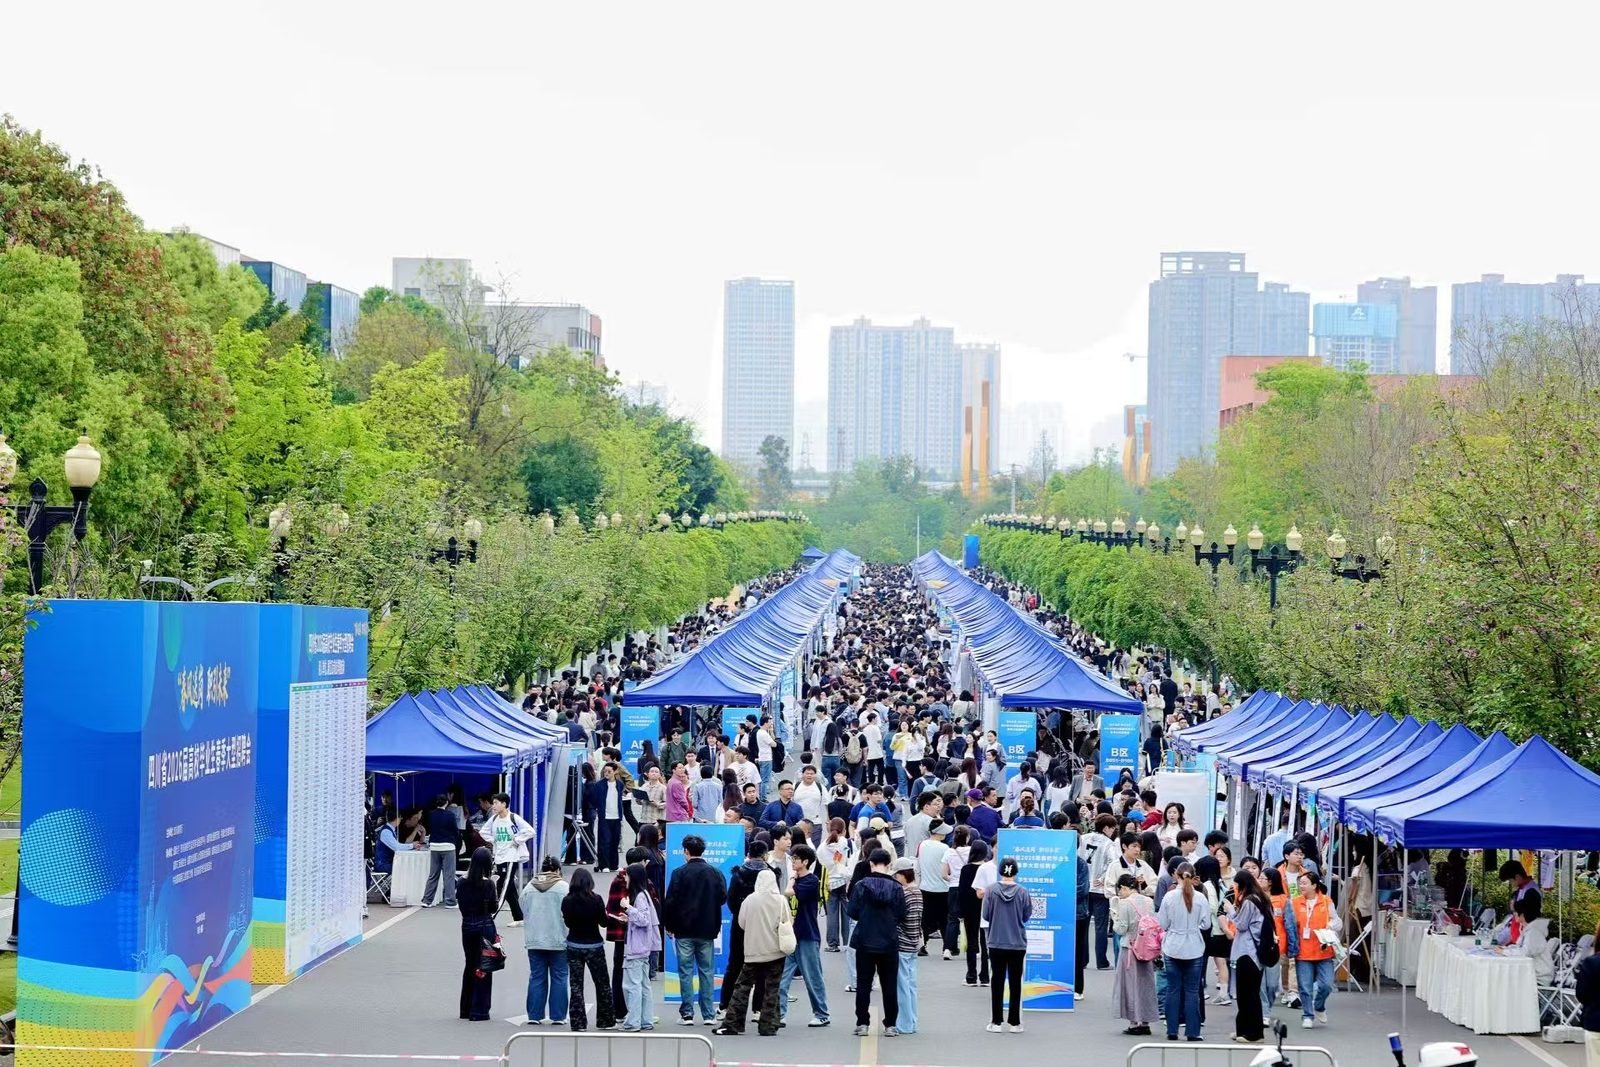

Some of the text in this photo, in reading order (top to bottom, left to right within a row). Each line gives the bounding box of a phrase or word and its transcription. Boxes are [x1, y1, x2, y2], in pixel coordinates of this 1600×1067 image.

[1008, 744, 1025, 754] B区
[1110, 747, 1129, 757] B区
[148, 733, 252, 790] 四川省2026届高校毕业生春季大型招聘会
[1086, 843, 1098, 864] 7
